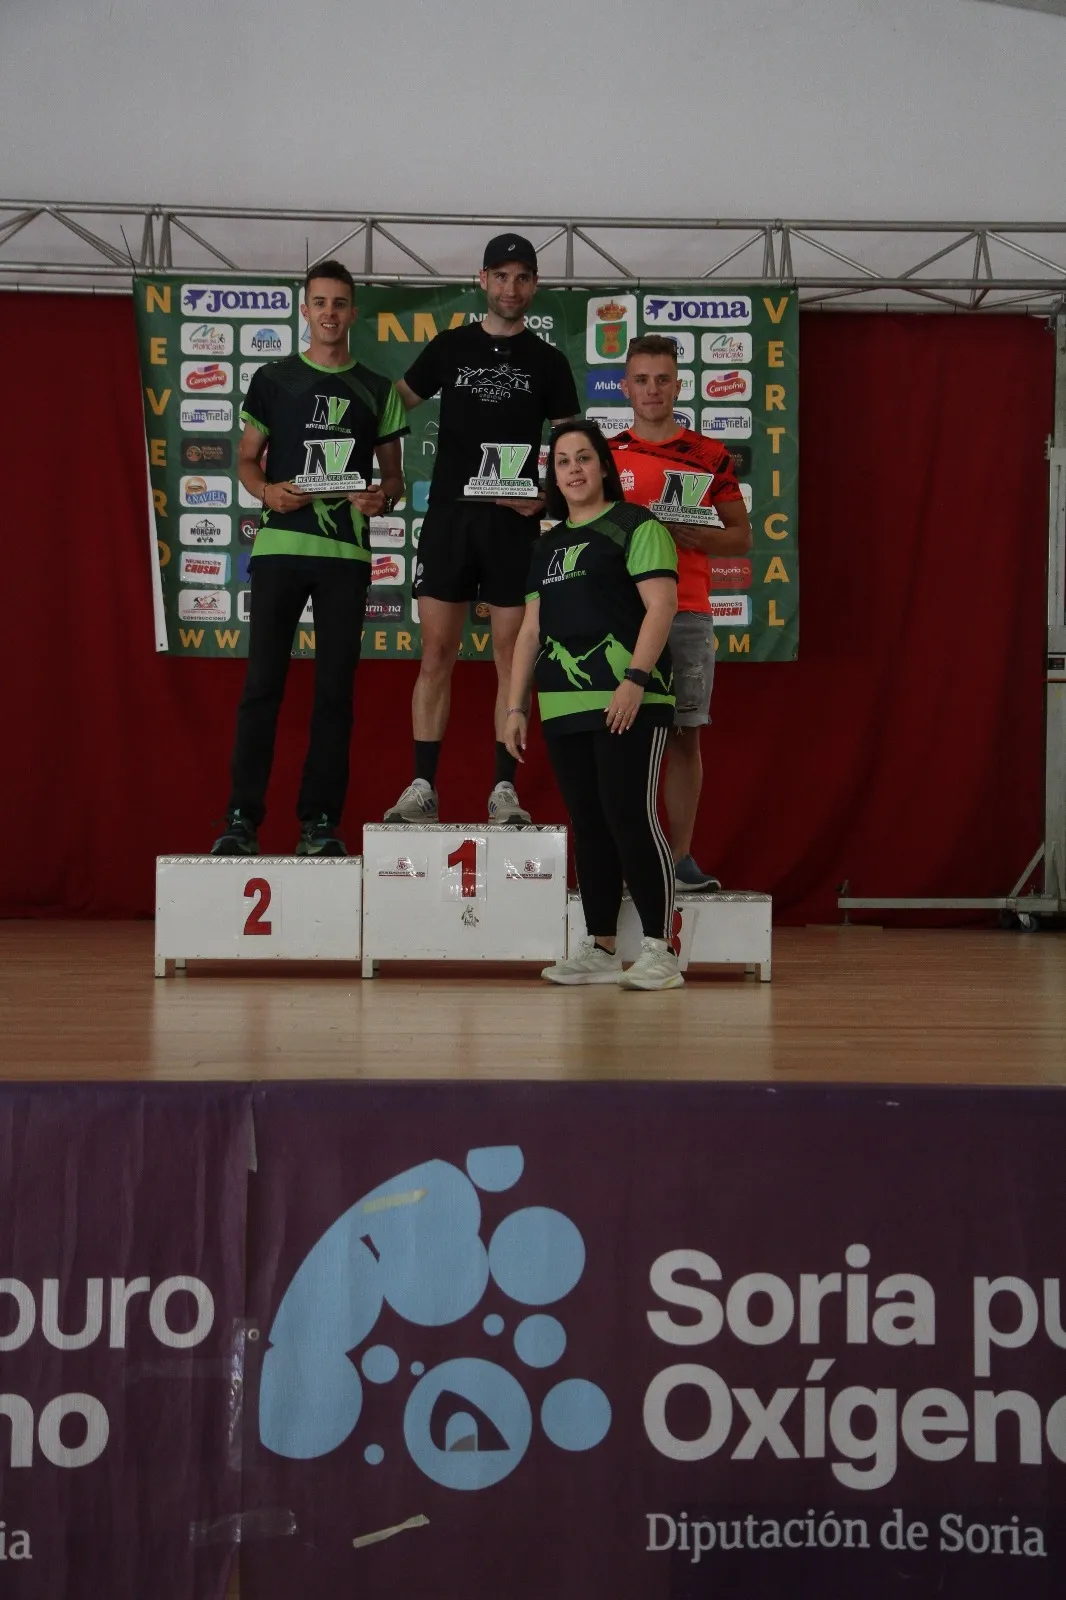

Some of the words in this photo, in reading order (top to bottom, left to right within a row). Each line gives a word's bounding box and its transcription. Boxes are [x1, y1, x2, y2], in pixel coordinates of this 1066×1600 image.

[251, 336, 282, 352] Agralco
[594, 381, 622, 390] Mube
[190, 528, 221, 536] MONCAYO
[448, 839, 477, 897] 1
[243, 877, 272, 935] 2
[646, 1243, 936, 1346] Soria
[646, 1509, 870, 1563] Diputación
[879, 1508, 929, 1552] de
[939, 1512, 1047, 1557] Soria
